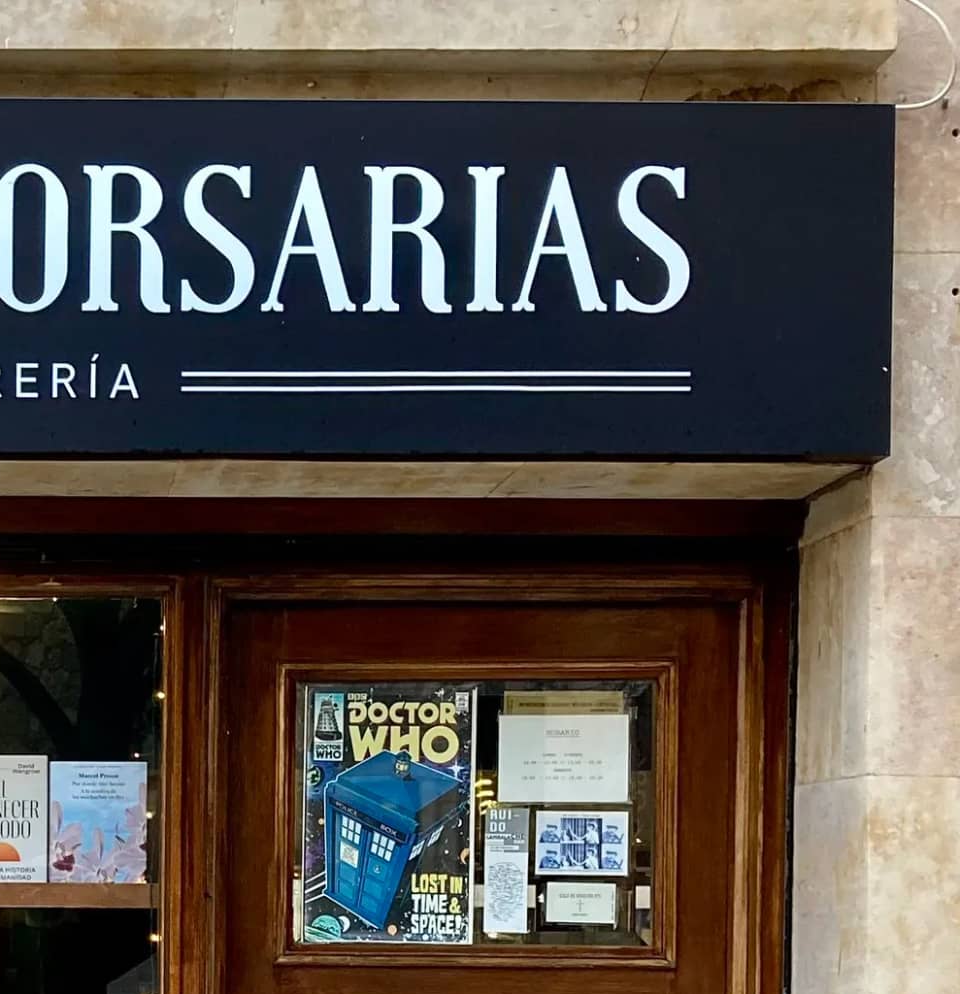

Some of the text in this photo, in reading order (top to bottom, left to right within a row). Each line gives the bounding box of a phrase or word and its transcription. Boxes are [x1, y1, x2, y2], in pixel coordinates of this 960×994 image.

[348, 702, 457, 724] DOCTOR
[316, 750, 341, 759] WHO
[349, 725, 460, 764] WHO
[380, 824, 398, 837] BOX
[411, 874, 463, 893] LOST IN
[412, 894, 461, 914] TIME &
[411, 914, 462, 934] SPACE!
